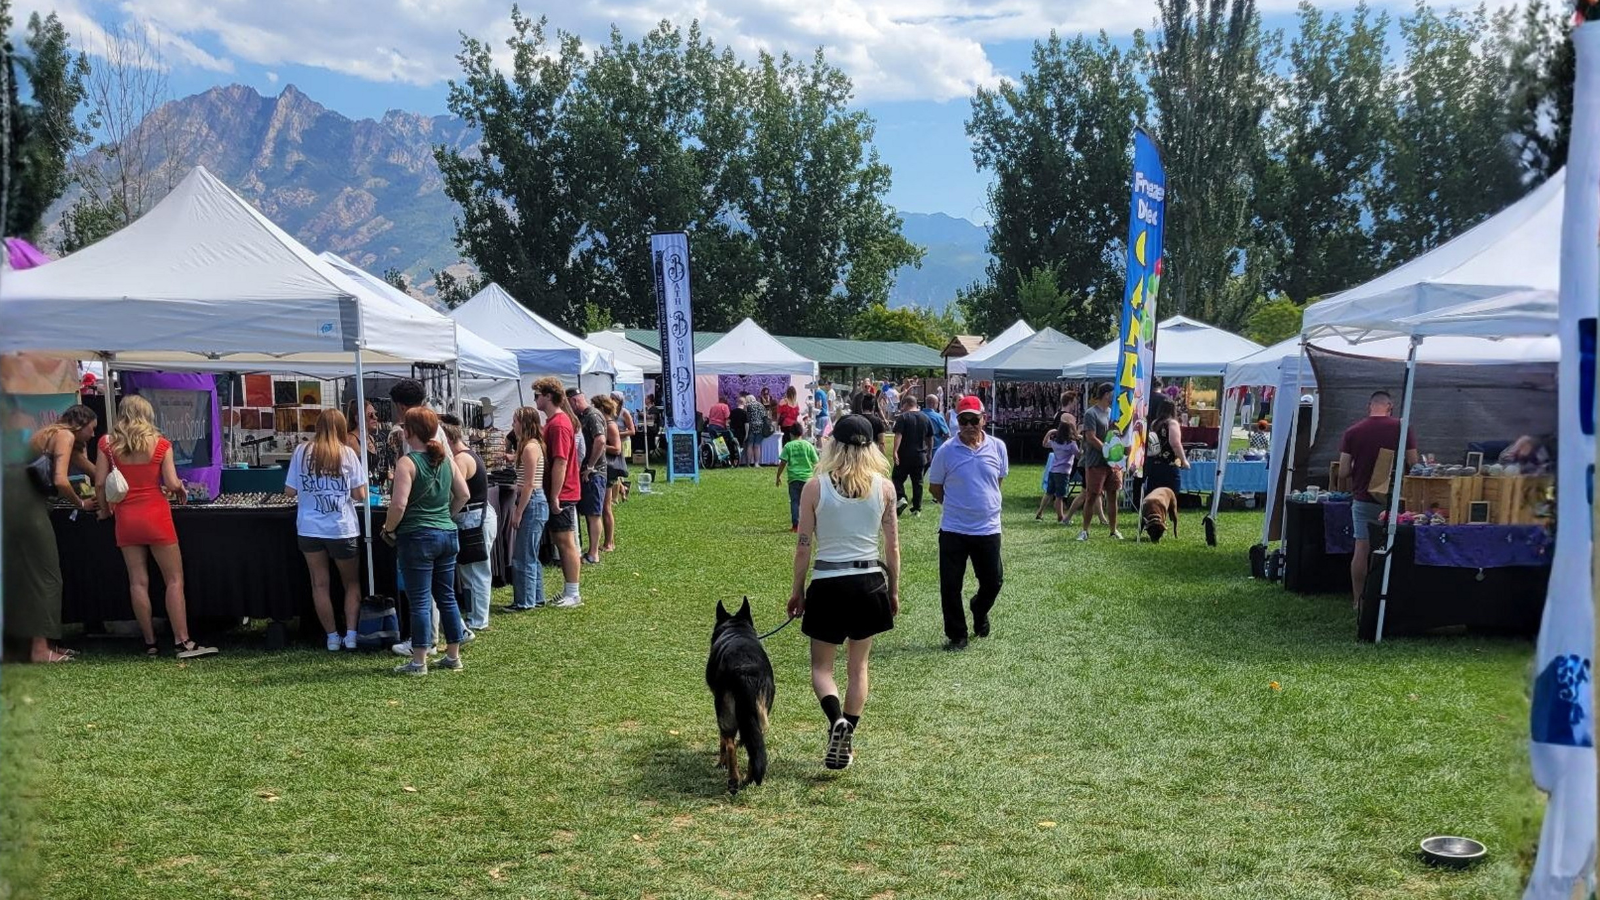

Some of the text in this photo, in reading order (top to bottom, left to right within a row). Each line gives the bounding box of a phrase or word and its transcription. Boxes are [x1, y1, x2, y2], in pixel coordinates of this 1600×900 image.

[666, 253, 685, 306] BATH
[670, 310, 688, 361] BOMB
[672, 365, 691, 416] DIVA
